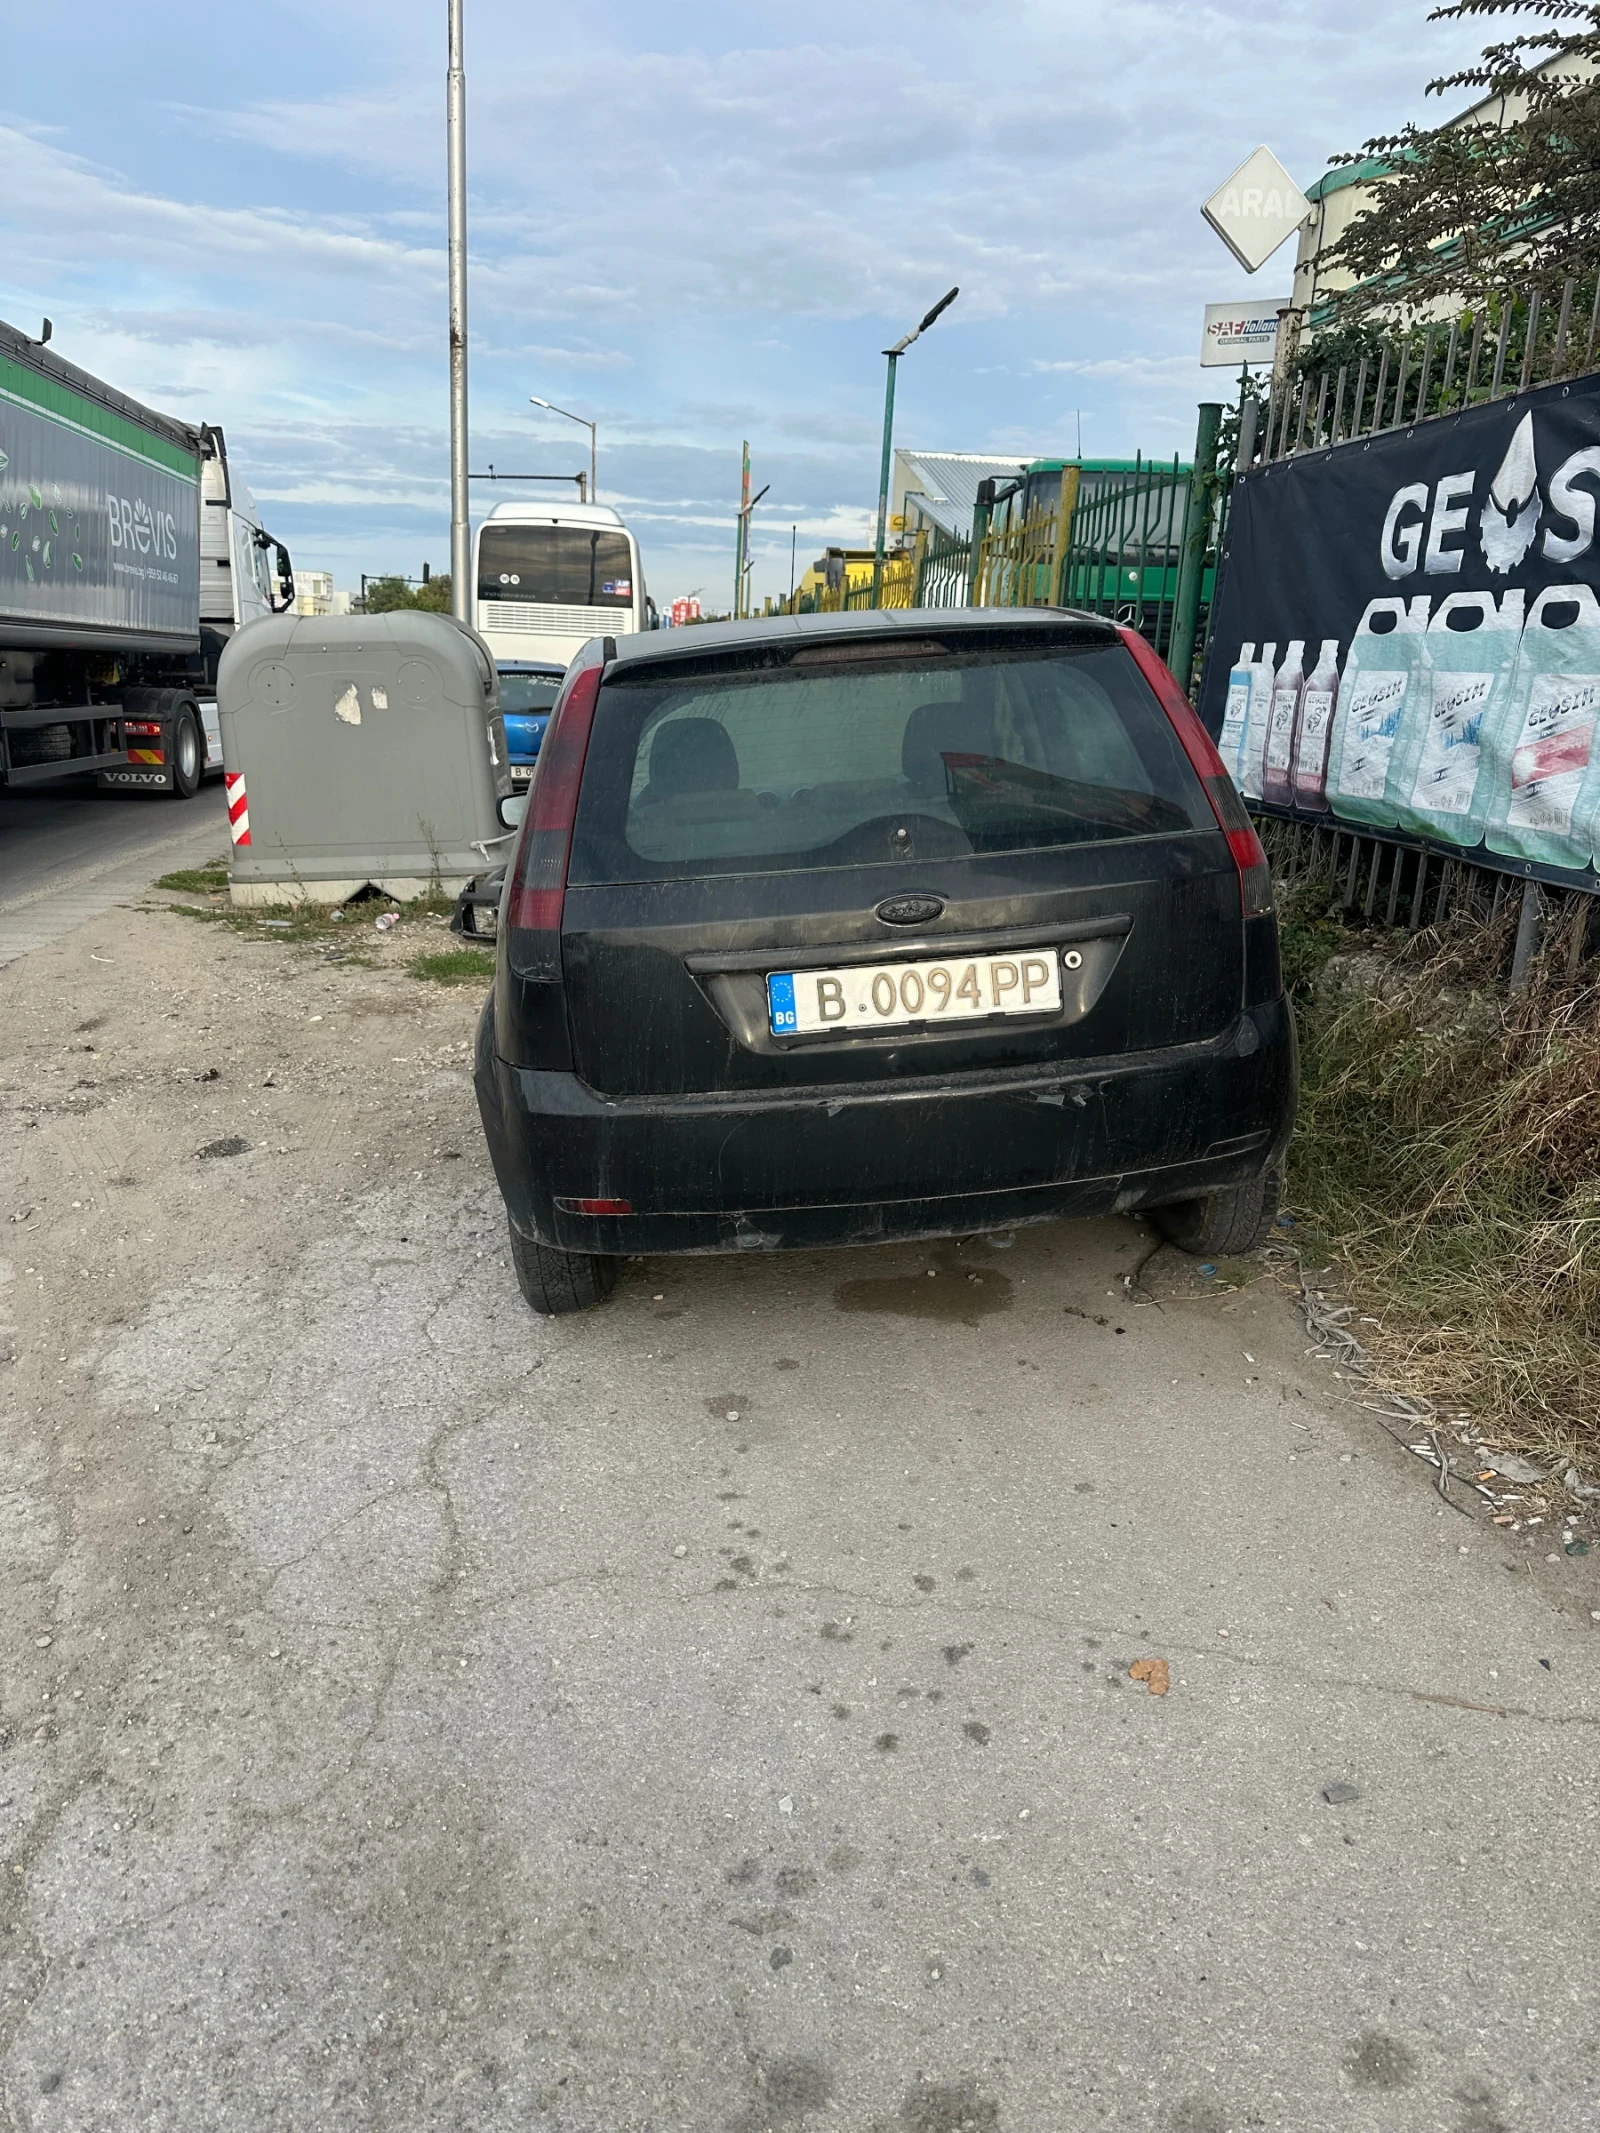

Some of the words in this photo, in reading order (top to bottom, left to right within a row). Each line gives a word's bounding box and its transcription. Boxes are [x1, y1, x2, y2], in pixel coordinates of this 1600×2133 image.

[1219, 188, 1303, 219] ARAL
[1209, 321, 1243, 336] SAF
[107, 494, 177, 560] BREVIS
[103, 772, 167, 784] VOLVO
[816, 976, 847, 1022] B
[775, 1010, 795, 1026] BG
